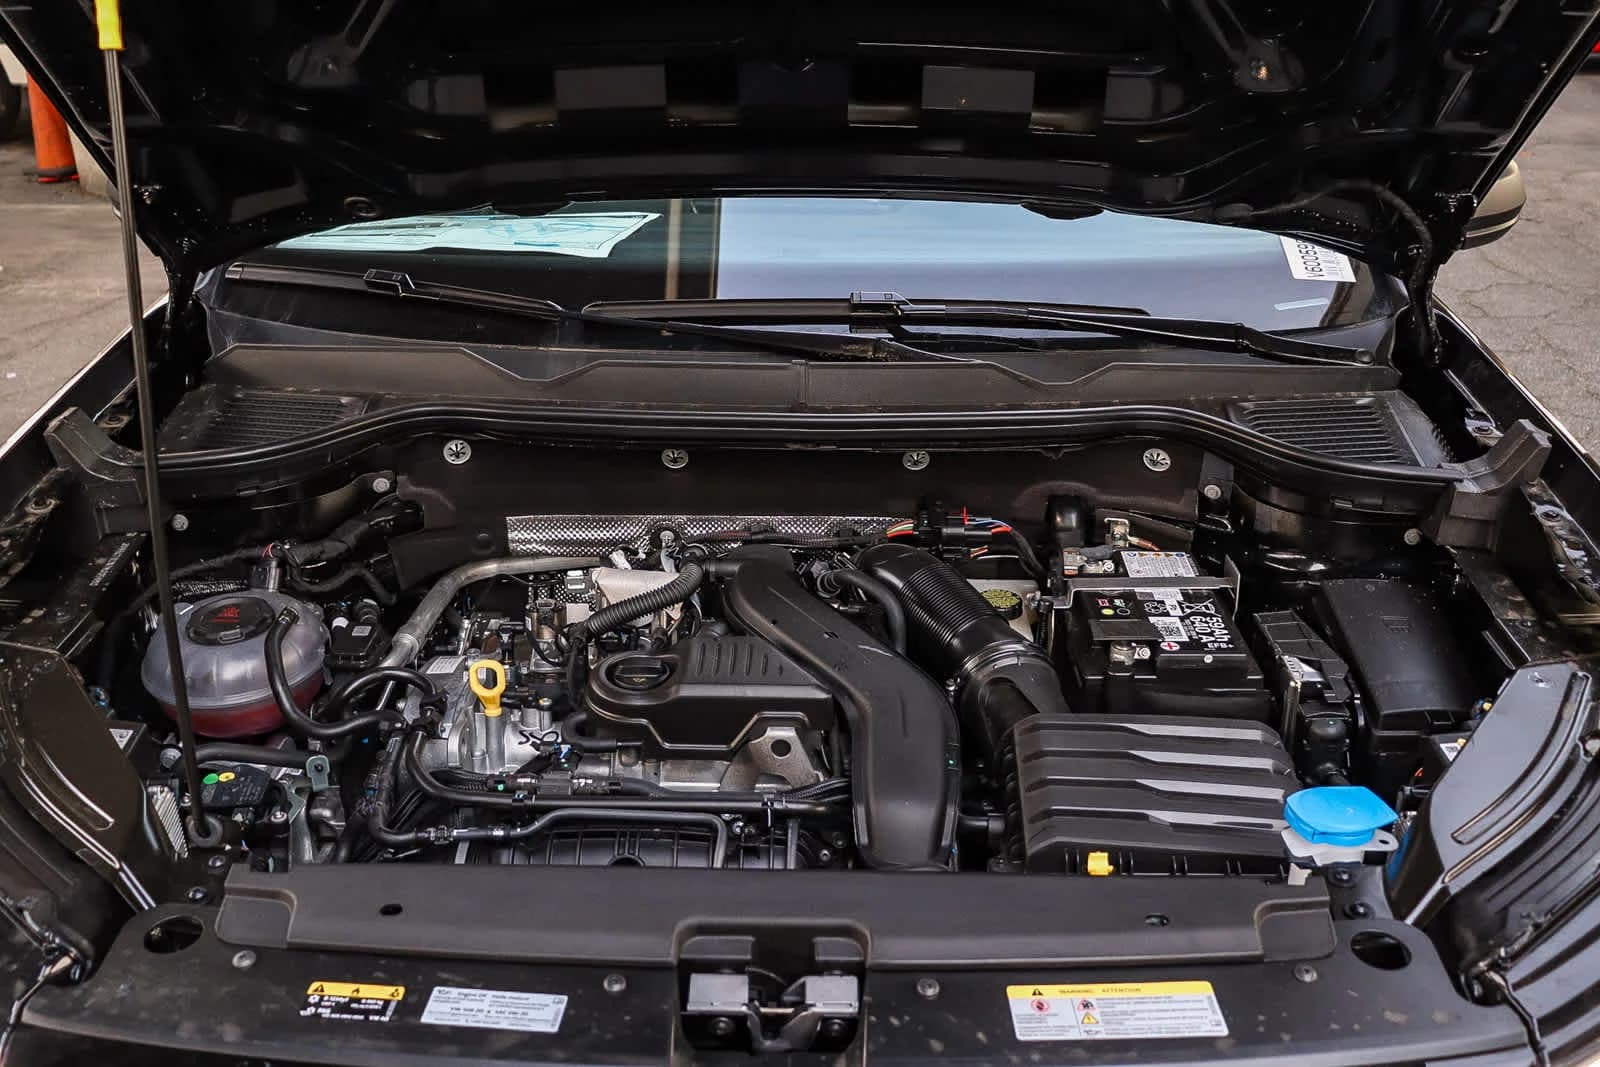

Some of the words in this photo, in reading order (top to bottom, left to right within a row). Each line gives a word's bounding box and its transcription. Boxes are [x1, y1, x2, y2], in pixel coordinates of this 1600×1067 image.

[1189, 616, 1209, 633] 640
[1206, 616, 1231, 642] 59Ah
[1198, 634, 1215, 643] A
